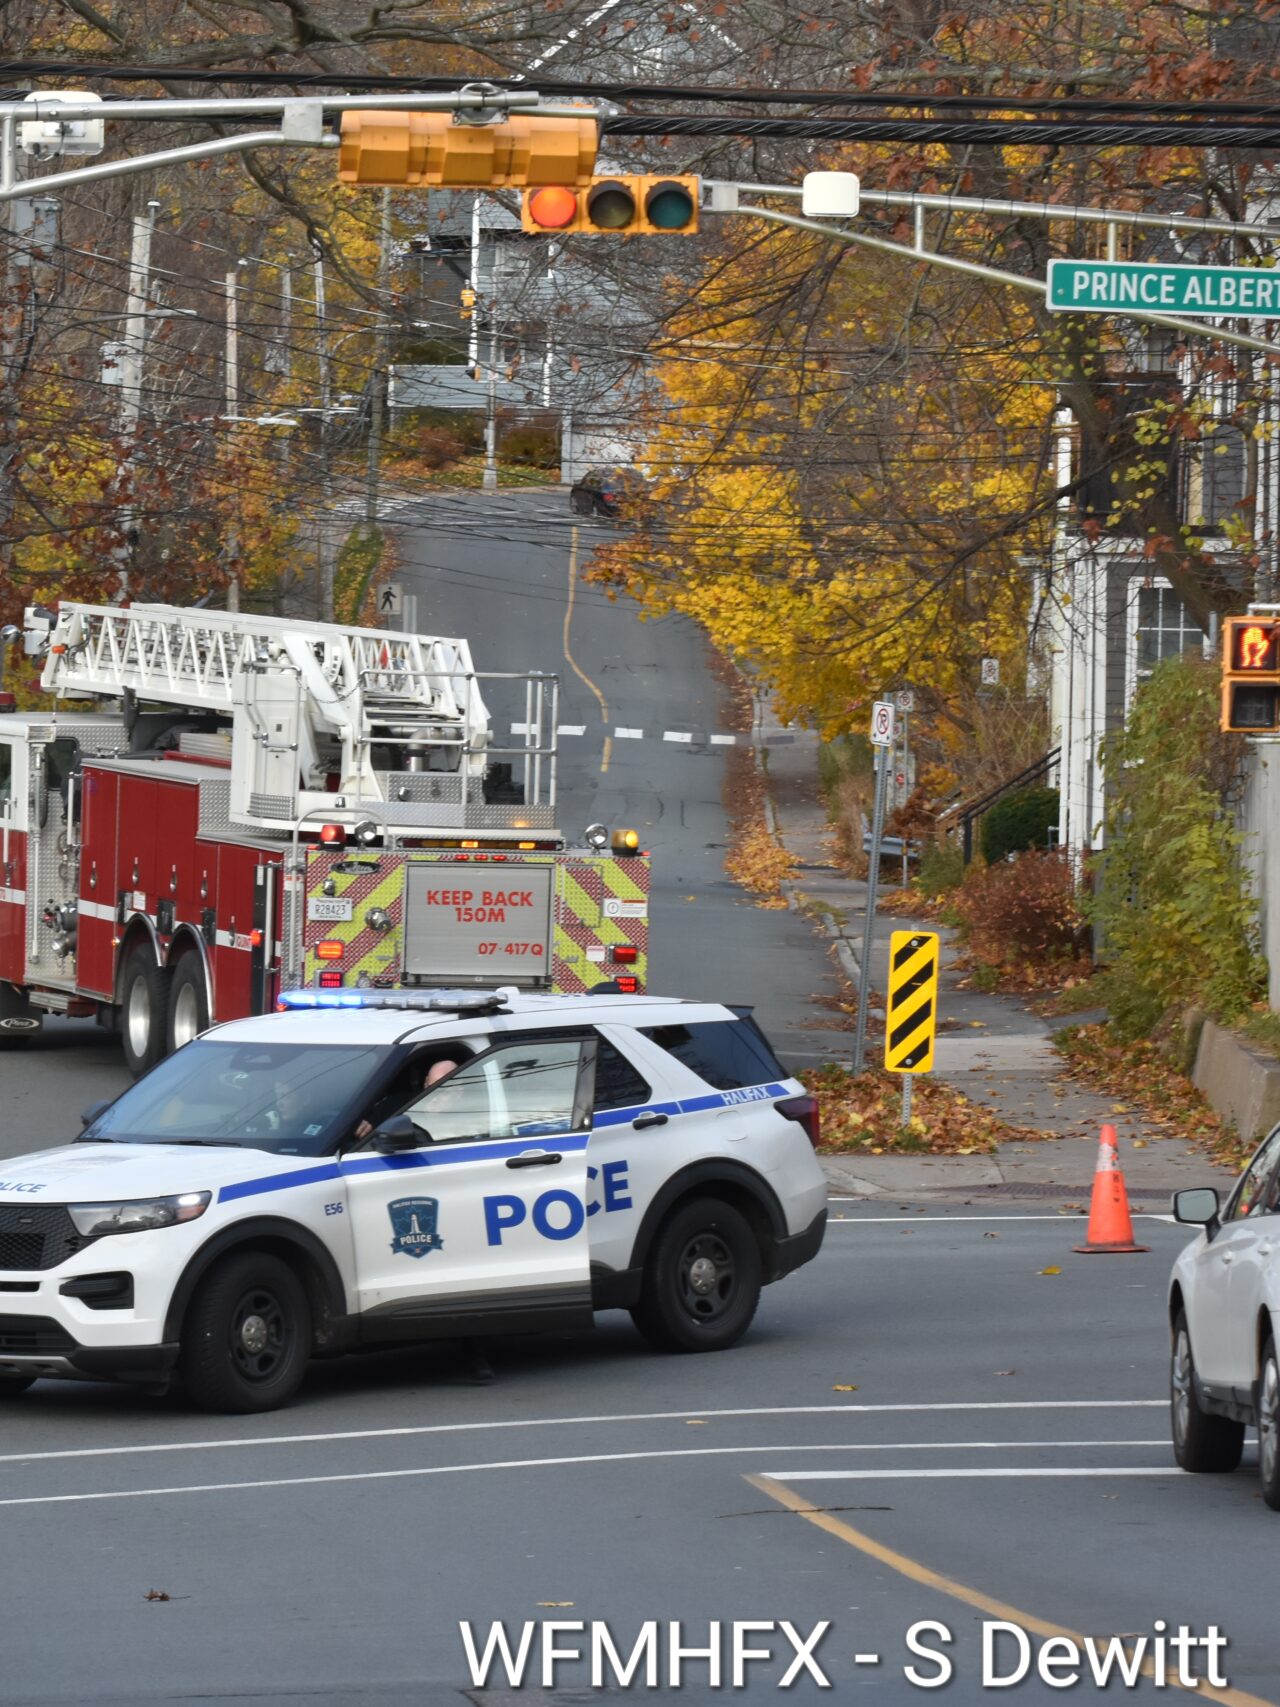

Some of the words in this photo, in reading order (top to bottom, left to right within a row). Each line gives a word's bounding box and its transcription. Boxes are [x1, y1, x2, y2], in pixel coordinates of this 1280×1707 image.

[1072, 270, 1176, 304] PRINCE
[426, 890, 474, 906] KEEP
[482, 891, 534, 907] BACK
[455, 907, 505, 923] 150M
[720, 1086, 772, 1106] HALIFAX
[323, 1202, 344, 1217] E56
[400, 1234, 433, 1246] POLICE
